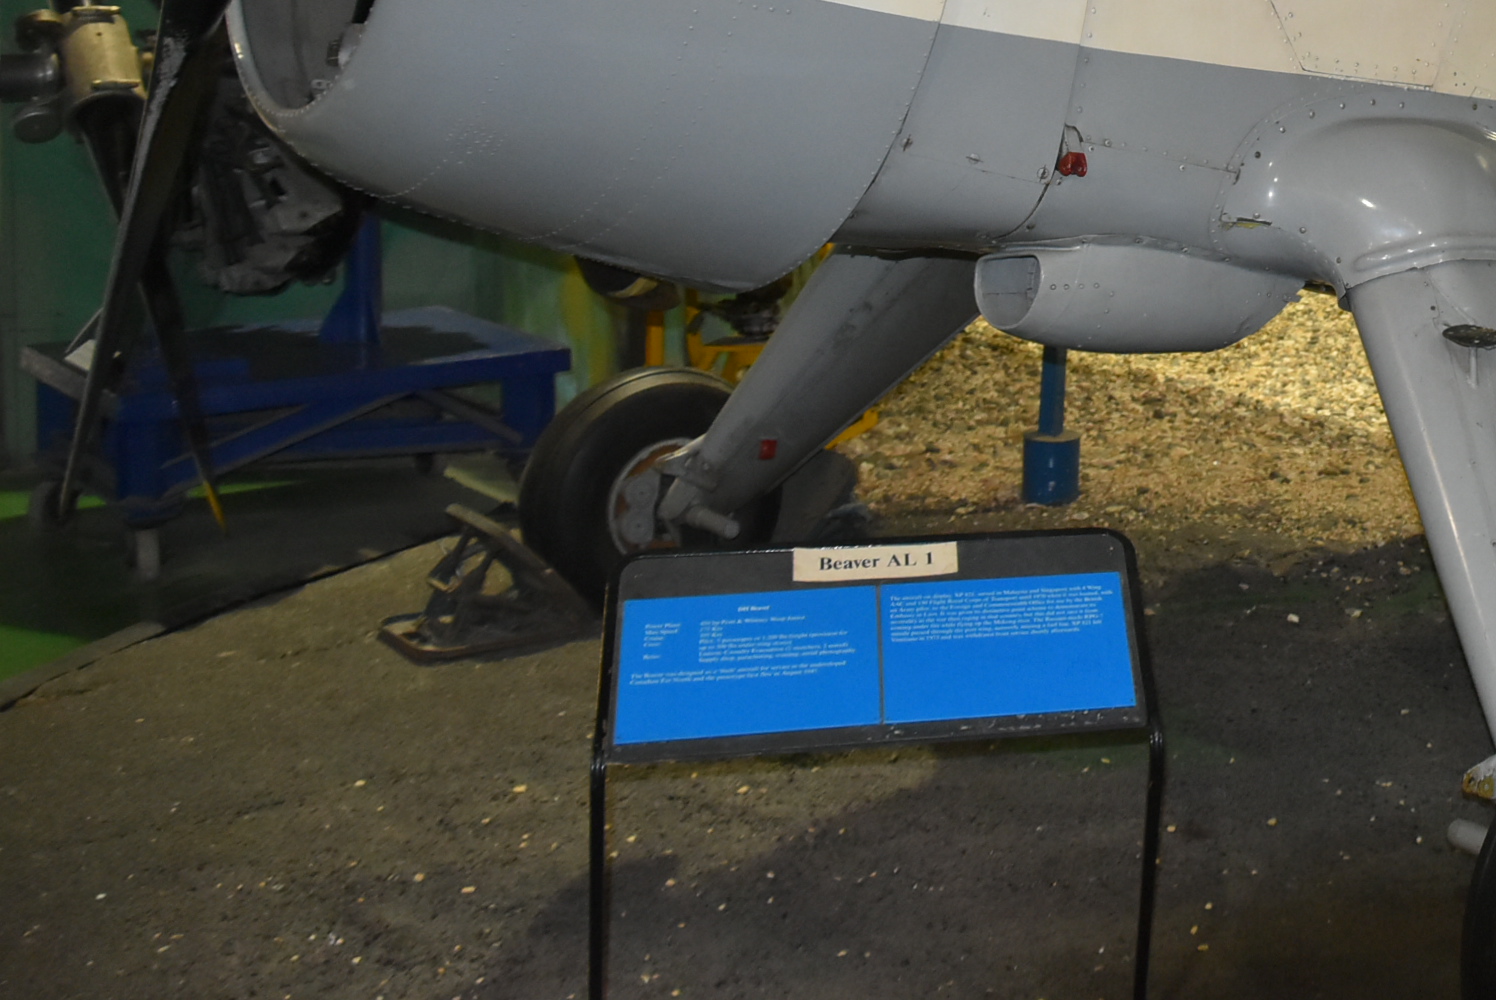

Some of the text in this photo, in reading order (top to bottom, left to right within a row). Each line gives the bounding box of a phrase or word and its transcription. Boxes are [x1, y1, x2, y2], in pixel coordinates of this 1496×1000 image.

[819, 551, 933, 571] Beaver AL 1
